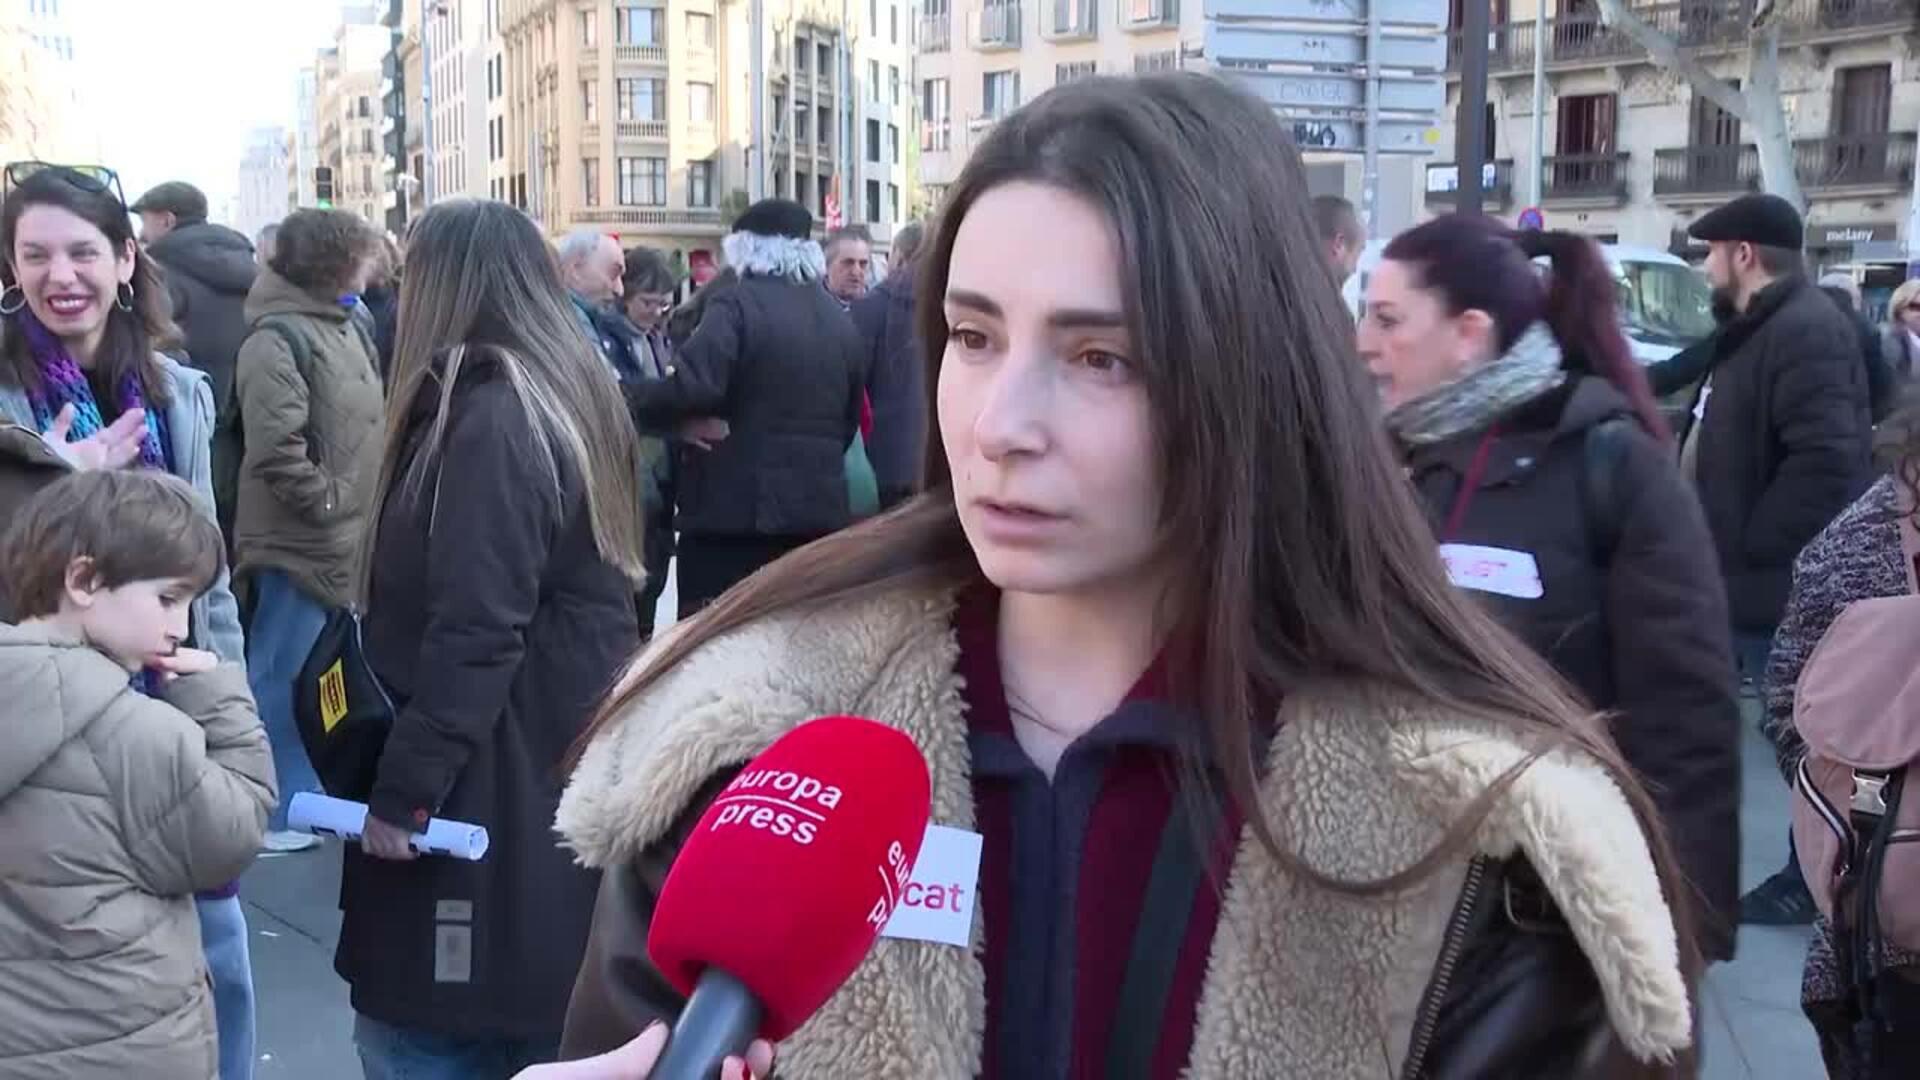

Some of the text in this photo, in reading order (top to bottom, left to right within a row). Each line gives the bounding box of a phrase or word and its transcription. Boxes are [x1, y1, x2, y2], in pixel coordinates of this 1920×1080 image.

[1825, 227, 1873, 243] melany
[710, 804, 818, 845] press
[902, 882, 965, 913] cat
